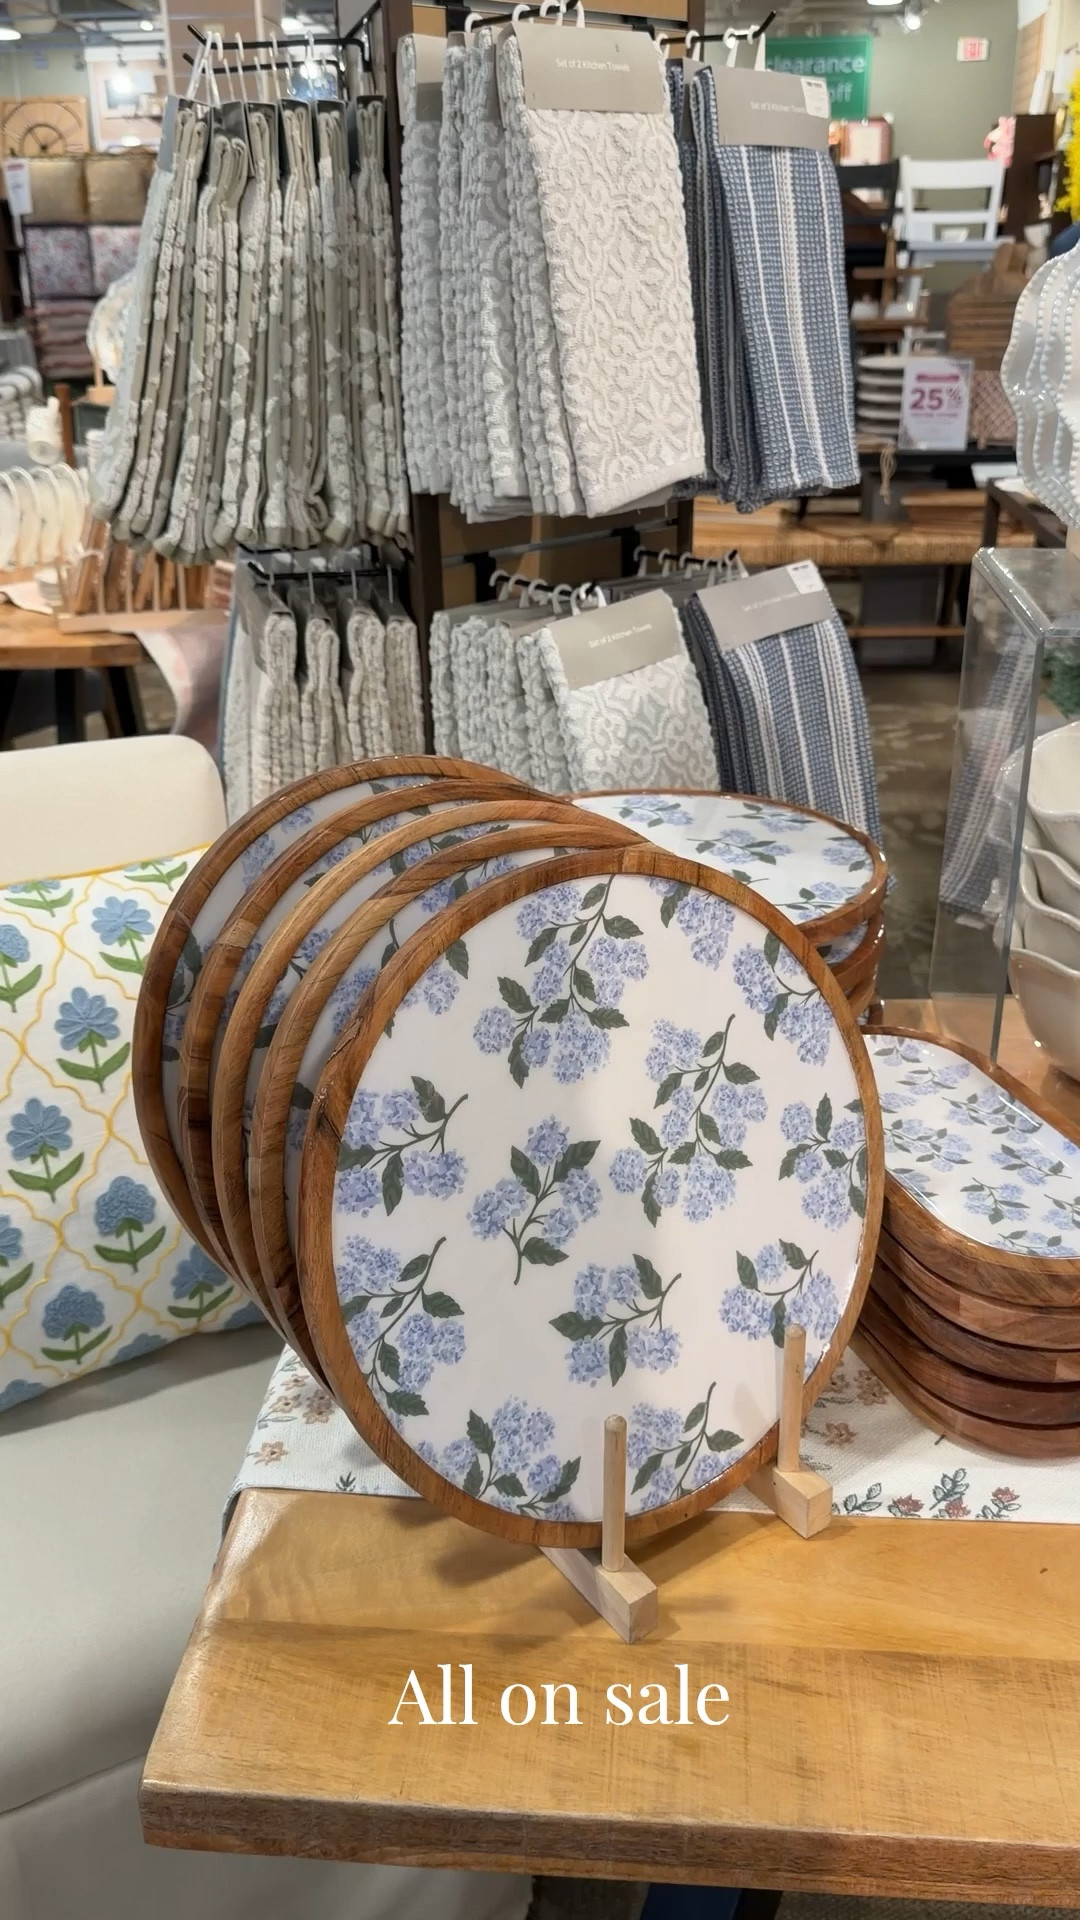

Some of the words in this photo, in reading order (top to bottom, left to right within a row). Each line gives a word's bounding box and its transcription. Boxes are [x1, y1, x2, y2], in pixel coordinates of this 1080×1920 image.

[556, 58, 568, 68] Set
[568, 59, 576, 69] of
[576, 60, 582, 69] 2
[582, 60, 607, 71] Kitchen
[606, 61, 630, 72] Towels
